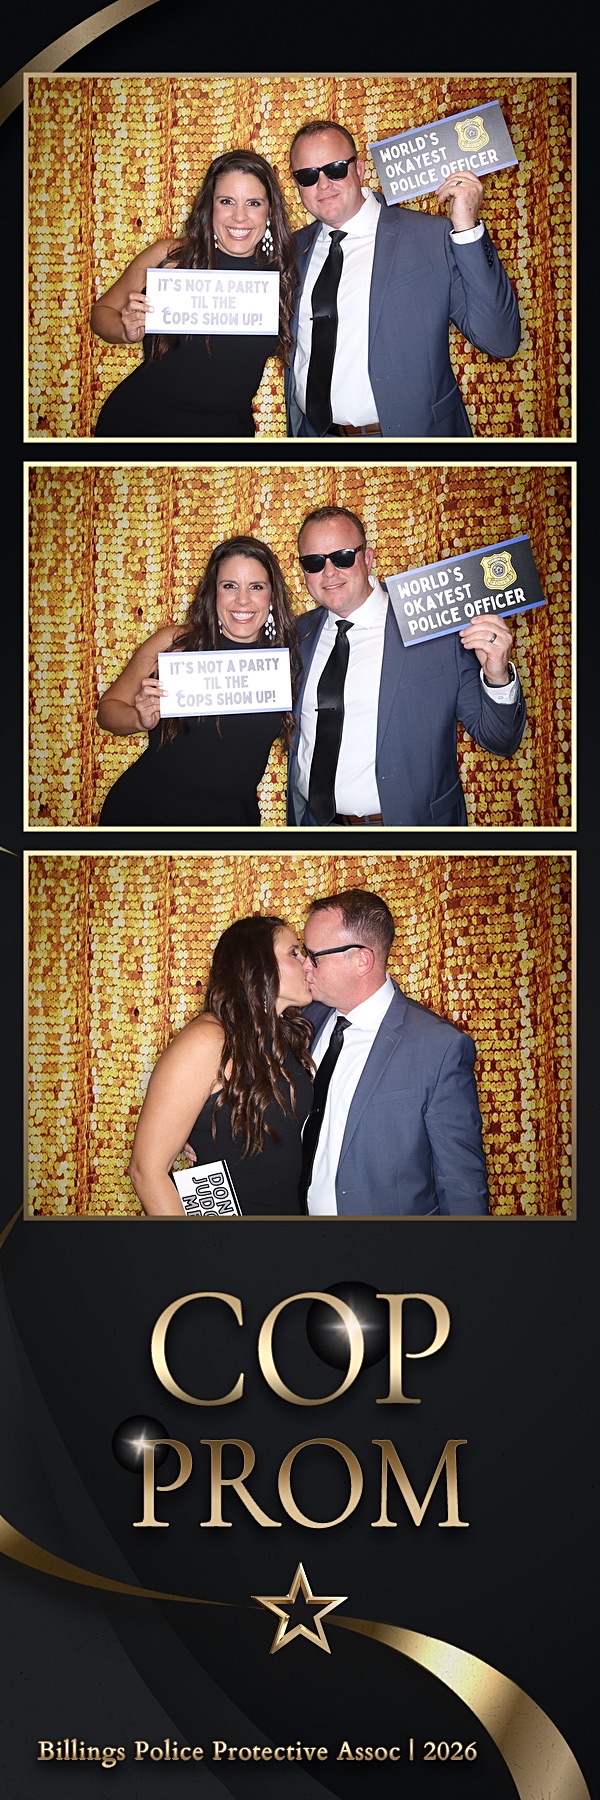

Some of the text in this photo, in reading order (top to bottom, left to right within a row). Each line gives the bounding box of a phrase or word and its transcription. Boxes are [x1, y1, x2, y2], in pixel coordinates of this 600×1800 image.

[379, 132, 439, 163] WORLD'S
[385, 147, 447, 178] OKAYEST
[440, 149, 499, 178] OFFICER
[389, 168, 438, 195] POLICE
[185, 279, 212, 292] NOT
[214, 279, 224, 293] A
[227, 280, 269, 293] PARTY
[162, 307, 263, 326] COPS SHOW UP!
[191, 296, 236, 309] TIL THE
[397, 566, 464, 599] WORLD'S
[403, 584, 472, 617] OKAYEST
[464, 587, 527, 618] OFFICER
[407, 606, 462, 636] POLICE
[197, 660, 223, 674] NOT
[226, 659, 236, 673] A
[239, 657, 280, 672] PARTY
[203, 675, 249, 690] TIL THE
[175, 689, 276, 708] COPS SHOW UP!
[208, 1172, 236, 1216] DON
